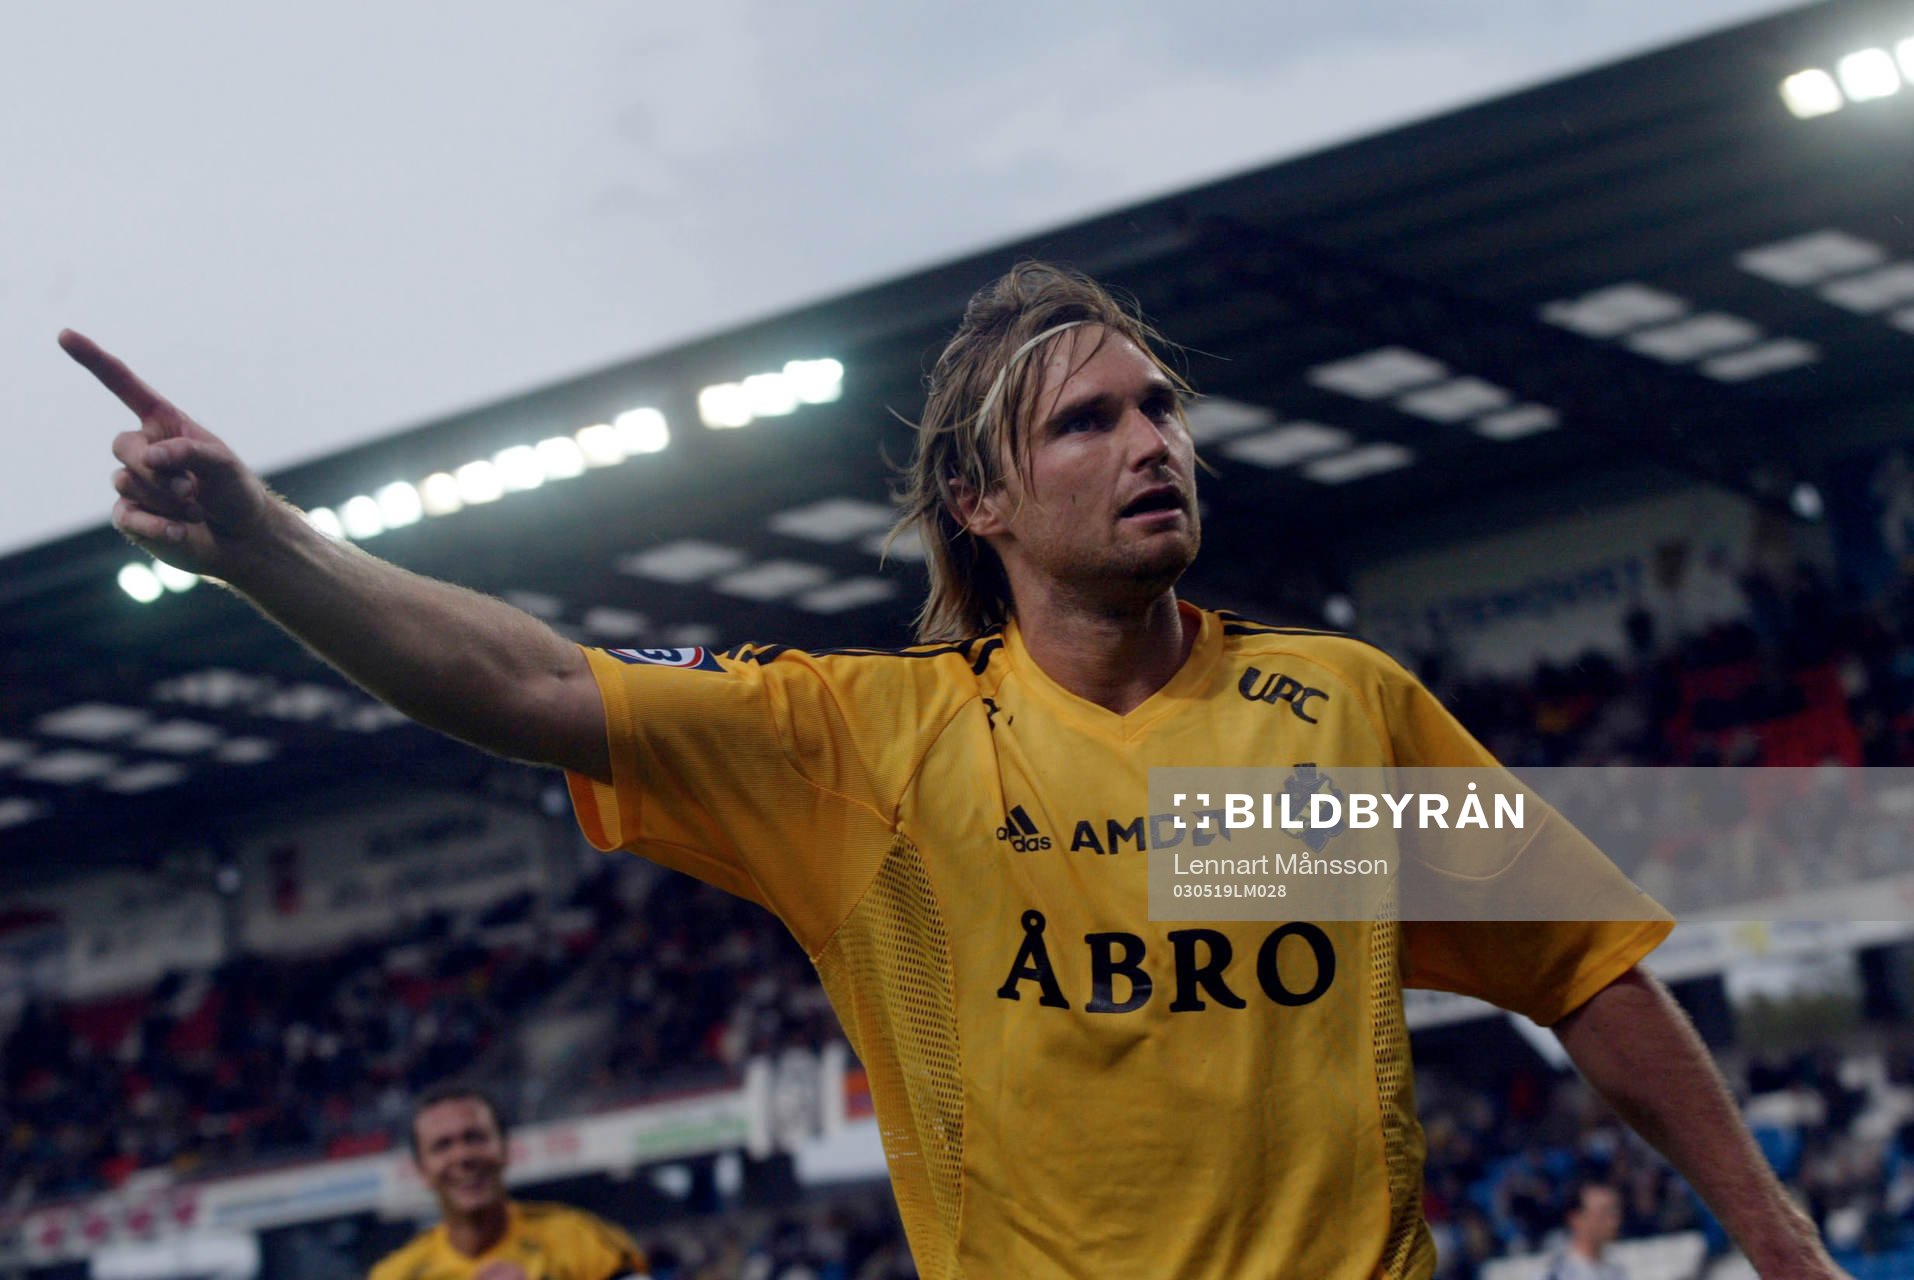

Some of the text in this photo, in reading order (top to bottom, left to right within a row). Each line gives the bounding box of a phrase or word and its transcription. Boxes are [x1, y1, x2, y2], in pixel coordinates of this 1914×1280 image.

[1238, 666, 1330, 724] UPC
[1070, 813, 1187, 855] AMD
[997, 909, 1336, 1014] ÅBRO
